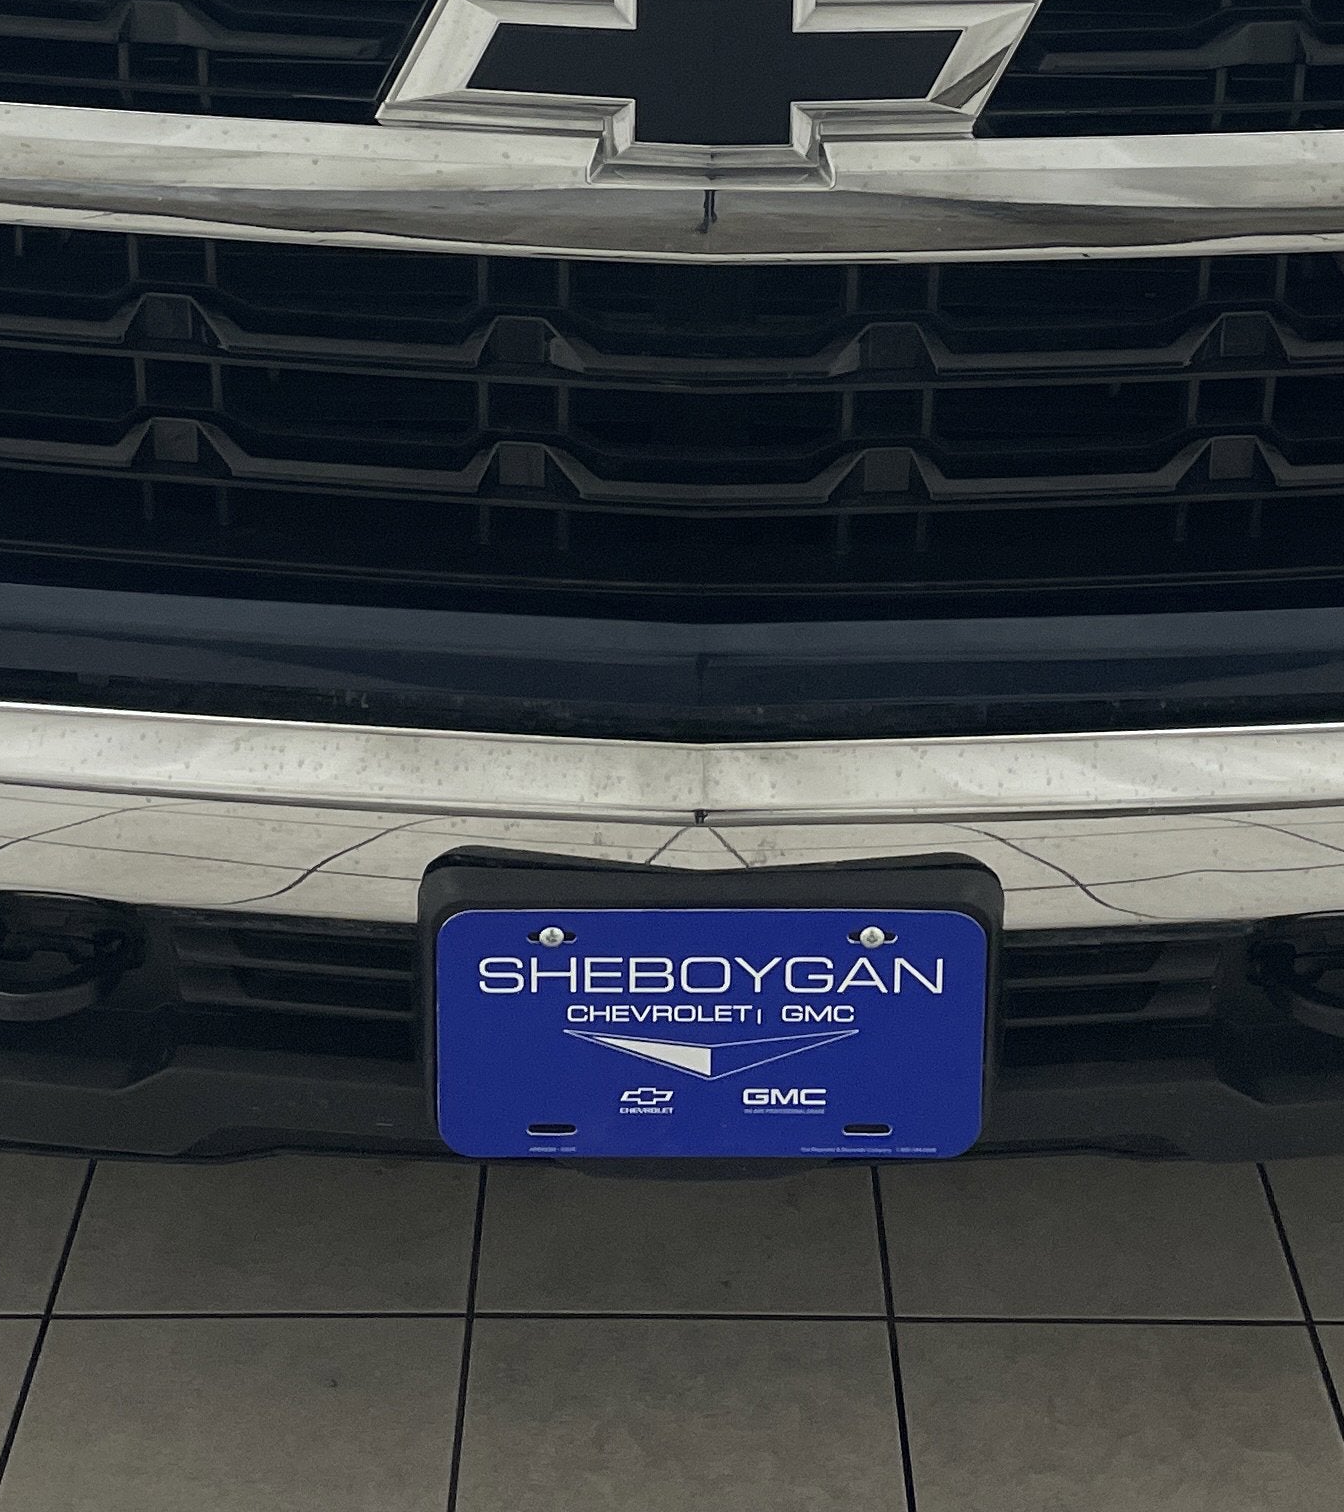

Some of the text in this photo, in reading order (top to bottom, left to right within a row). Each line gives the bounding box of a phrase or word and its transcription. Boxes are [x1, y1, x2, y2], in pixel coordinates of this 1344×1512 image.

[478, 956, 944, 994] SHEBOYGAN
[566, 1004, 855, 1023] CHEVROLET GMC
[742, 1088, 827, 1106] GMC
[619, 1107, 674, 1115] CHEVROLET
